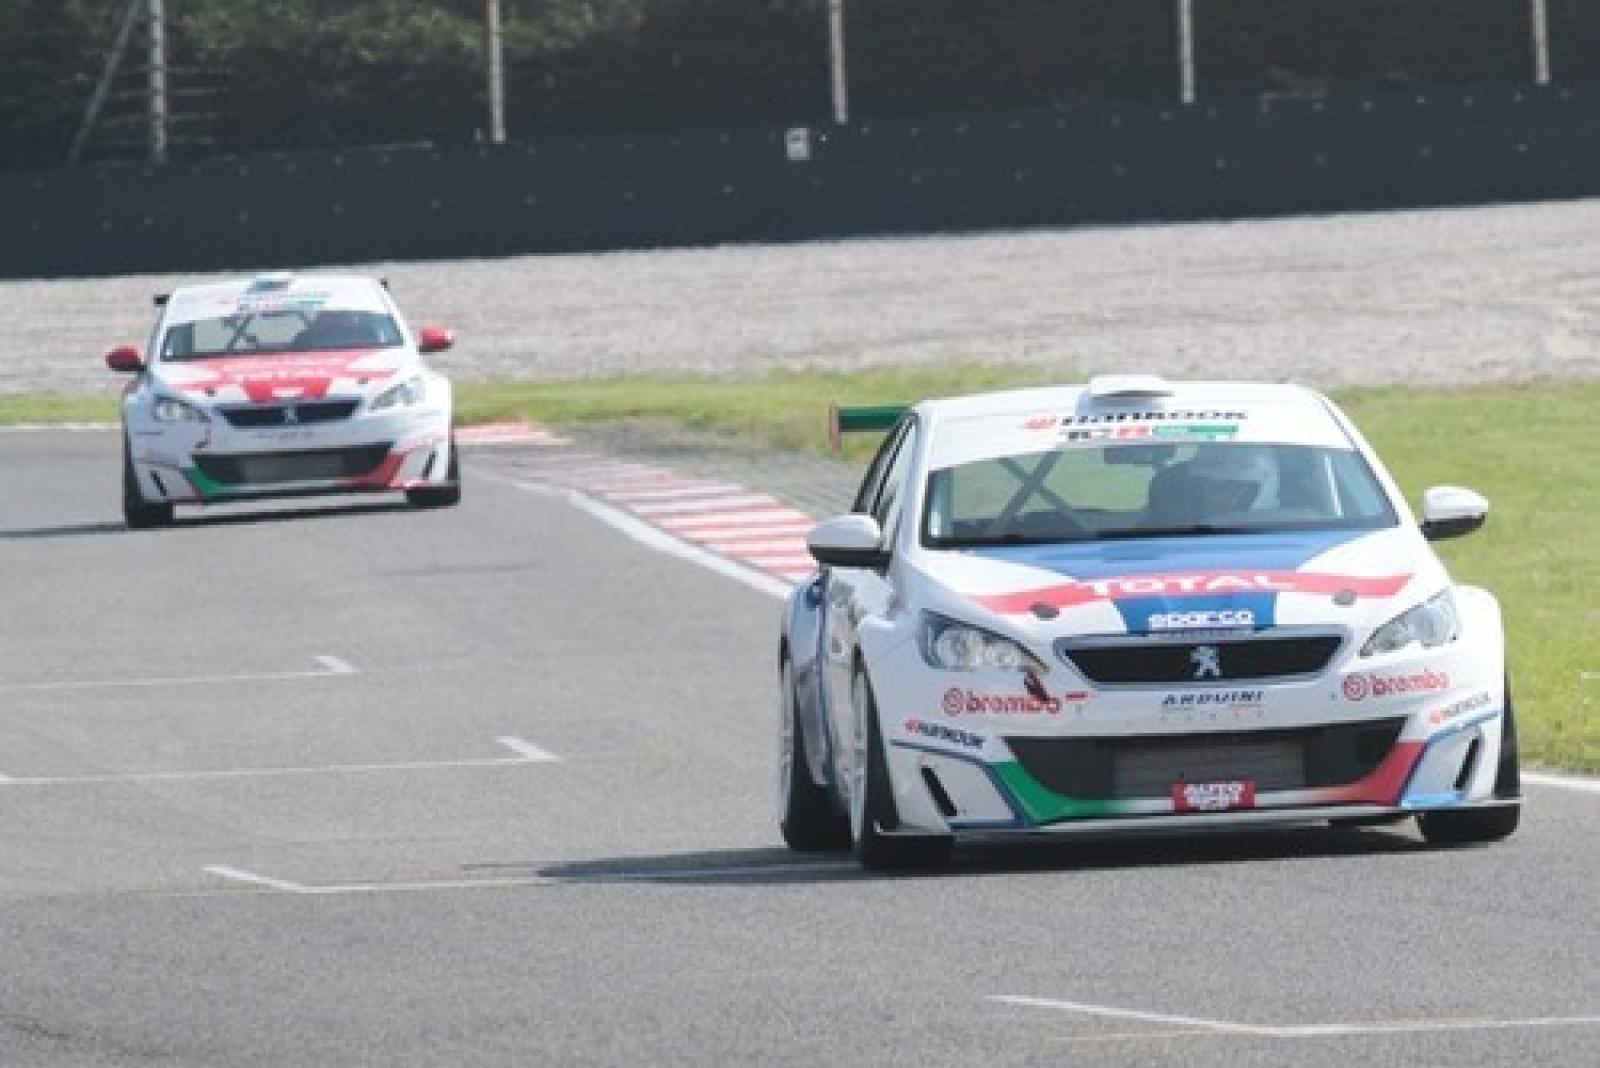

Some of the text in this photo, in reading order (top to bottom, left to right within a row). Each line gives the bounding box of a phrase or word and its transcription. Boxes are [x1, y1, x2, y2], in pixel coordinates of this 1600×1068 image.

[1076, 575, 1296, 596] TOTAL
[1369, 671, 1449, 696] brembo
[966, 690, 1061, 714] brembo
[1161, 691, 1265, 705] ARDUINI
